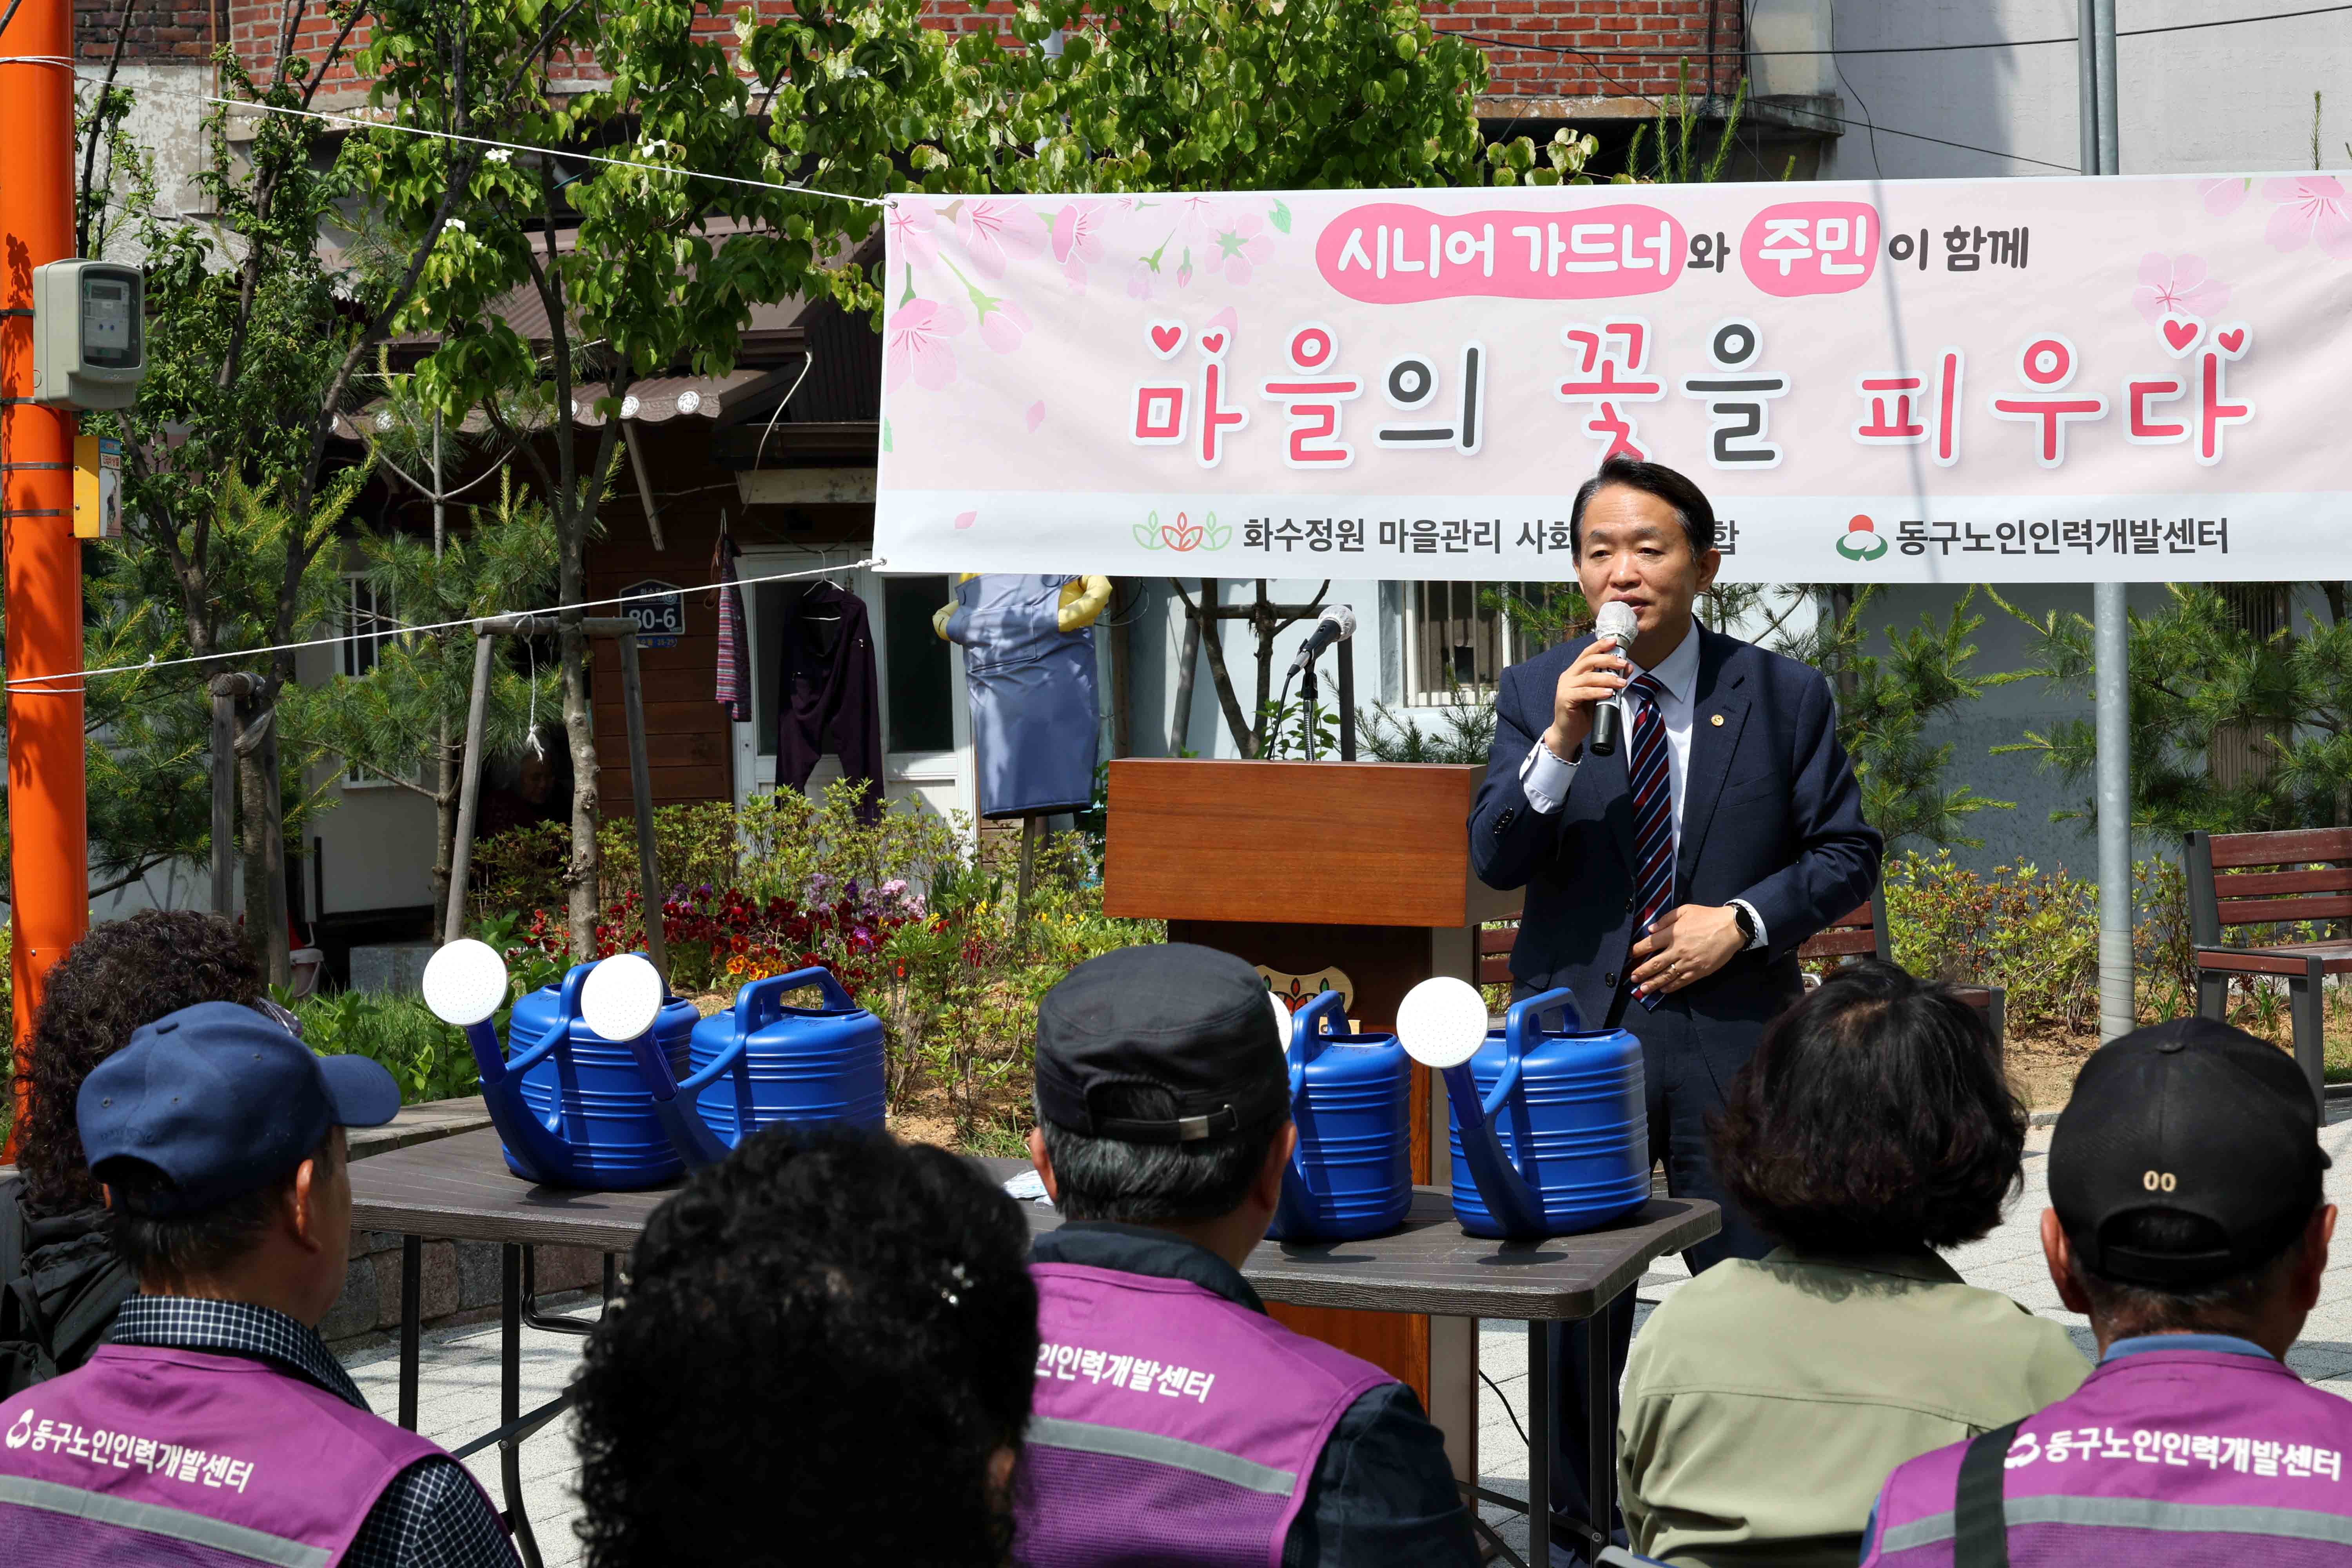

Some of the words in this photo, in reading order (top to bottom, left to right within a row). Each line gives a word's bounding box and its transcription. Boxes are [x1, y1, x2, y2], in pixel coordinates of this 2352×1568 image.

[1337, 222, 1495, 279] 시니어
[1512, 219, 1670, 277] 가드너
[1688, 232, 1730, 273] 와
[1763, 215, 1867, 276] 주민
[1889, 229, 1928, 271] 이
[1943, 225, 2029, 272] 함께
[1136, 326, 1479, 461] 마을의
[1560, 323, 1783, 464] 꽃을
[1858, 339, 2247, 460] 피우다
[1243, 517, 1364, 552] 화수정원
[1379, 518, 1500, 554] 마을관리
[1896, 517, 2228, 555] 동구노인인력개발센터
[32, 1419, 254, 1493] 동구노인인력개발센터
[2045, 1427, 2341, 1482] 동구노인인력개발센터
